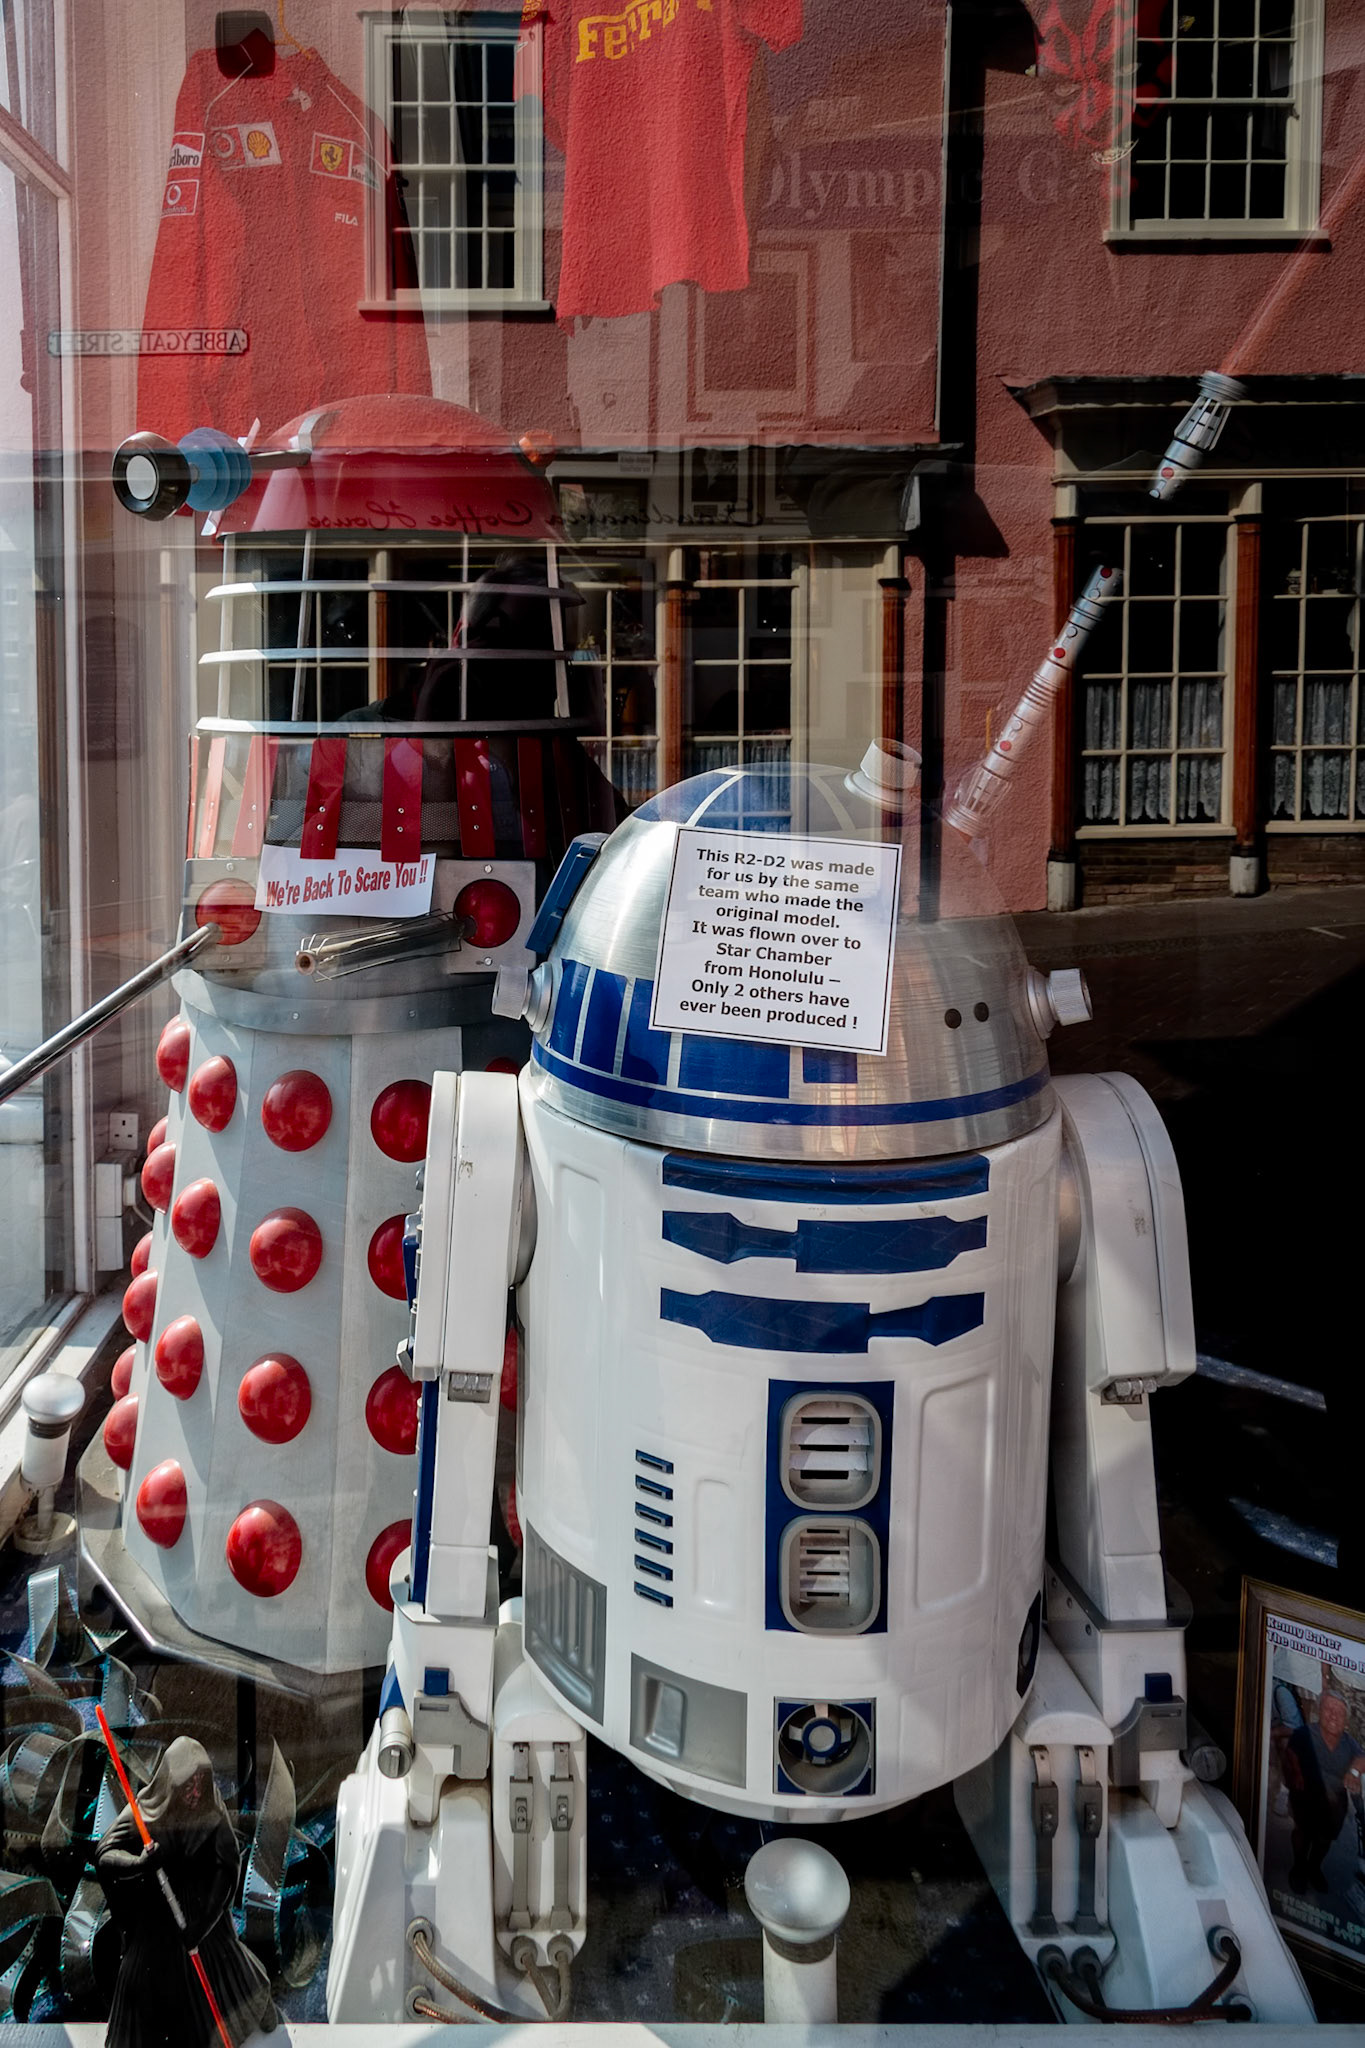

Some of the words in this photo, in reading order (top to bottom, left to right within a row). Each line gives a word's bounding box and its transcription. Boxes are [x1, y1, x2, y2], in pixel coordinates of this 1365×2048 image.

[334, 212, 359, 226] FILA
[697, 848, 729, 863] This
[734, 852, 786, 868] R2-D2
[791, 858, 823, 871] was
[828, 861, 875, 876] made
[266, 880, 300, 907] We're
[303, 872, 335, 902] Back
[338, 870, 351, 896] To
[354, 867, 390, 893] Scare
[395, 862, 417, 888] You
[706, 867, 730, 881] for
[734, 871, 753, 883] us
[758, 872, 778, 888] by
[782, 874, 810, 888] the
[814, 881, 859, 893] same
[698, 885, 739, 900] team
[745, 889, 780, 903] who
[785, 894, 831, 908] made
[835, 897, 864, 912] the
[716, 904, 779, 922] original
[784, 913, 840, 928] model.
[692, 920, 707, 934] It
[712, 924, 744, 938] was
[749, 926, 796, 943] flown
[801, 934, 839, 948] over
[844, 936, 861, 950] to
[716, 943, 751, 958] Star
[756, 946, 832, 966] Chamber
[704, 961, 743, 976] from
[749, 965, 824, 985] Honolulu
[691, 979, 728, 997] Only
[734, 983, 744, 997] 2
[749, 986, 803, 1003] others
[809, 991, 850, 1008] have
[680, 1000, 716, 1014] ever
[721, 1002, 761, 1018] been
[767, 1008, 846, 1028] produced
[852, 1016, 858, 1029] !
[1267, 1616, 1304, 1640] Kenny
[1305, 1628, 1341, 1651] Baker
[1267, 1630, 1289, 1647] The
[1289, 1640, 1316, 1657] man
